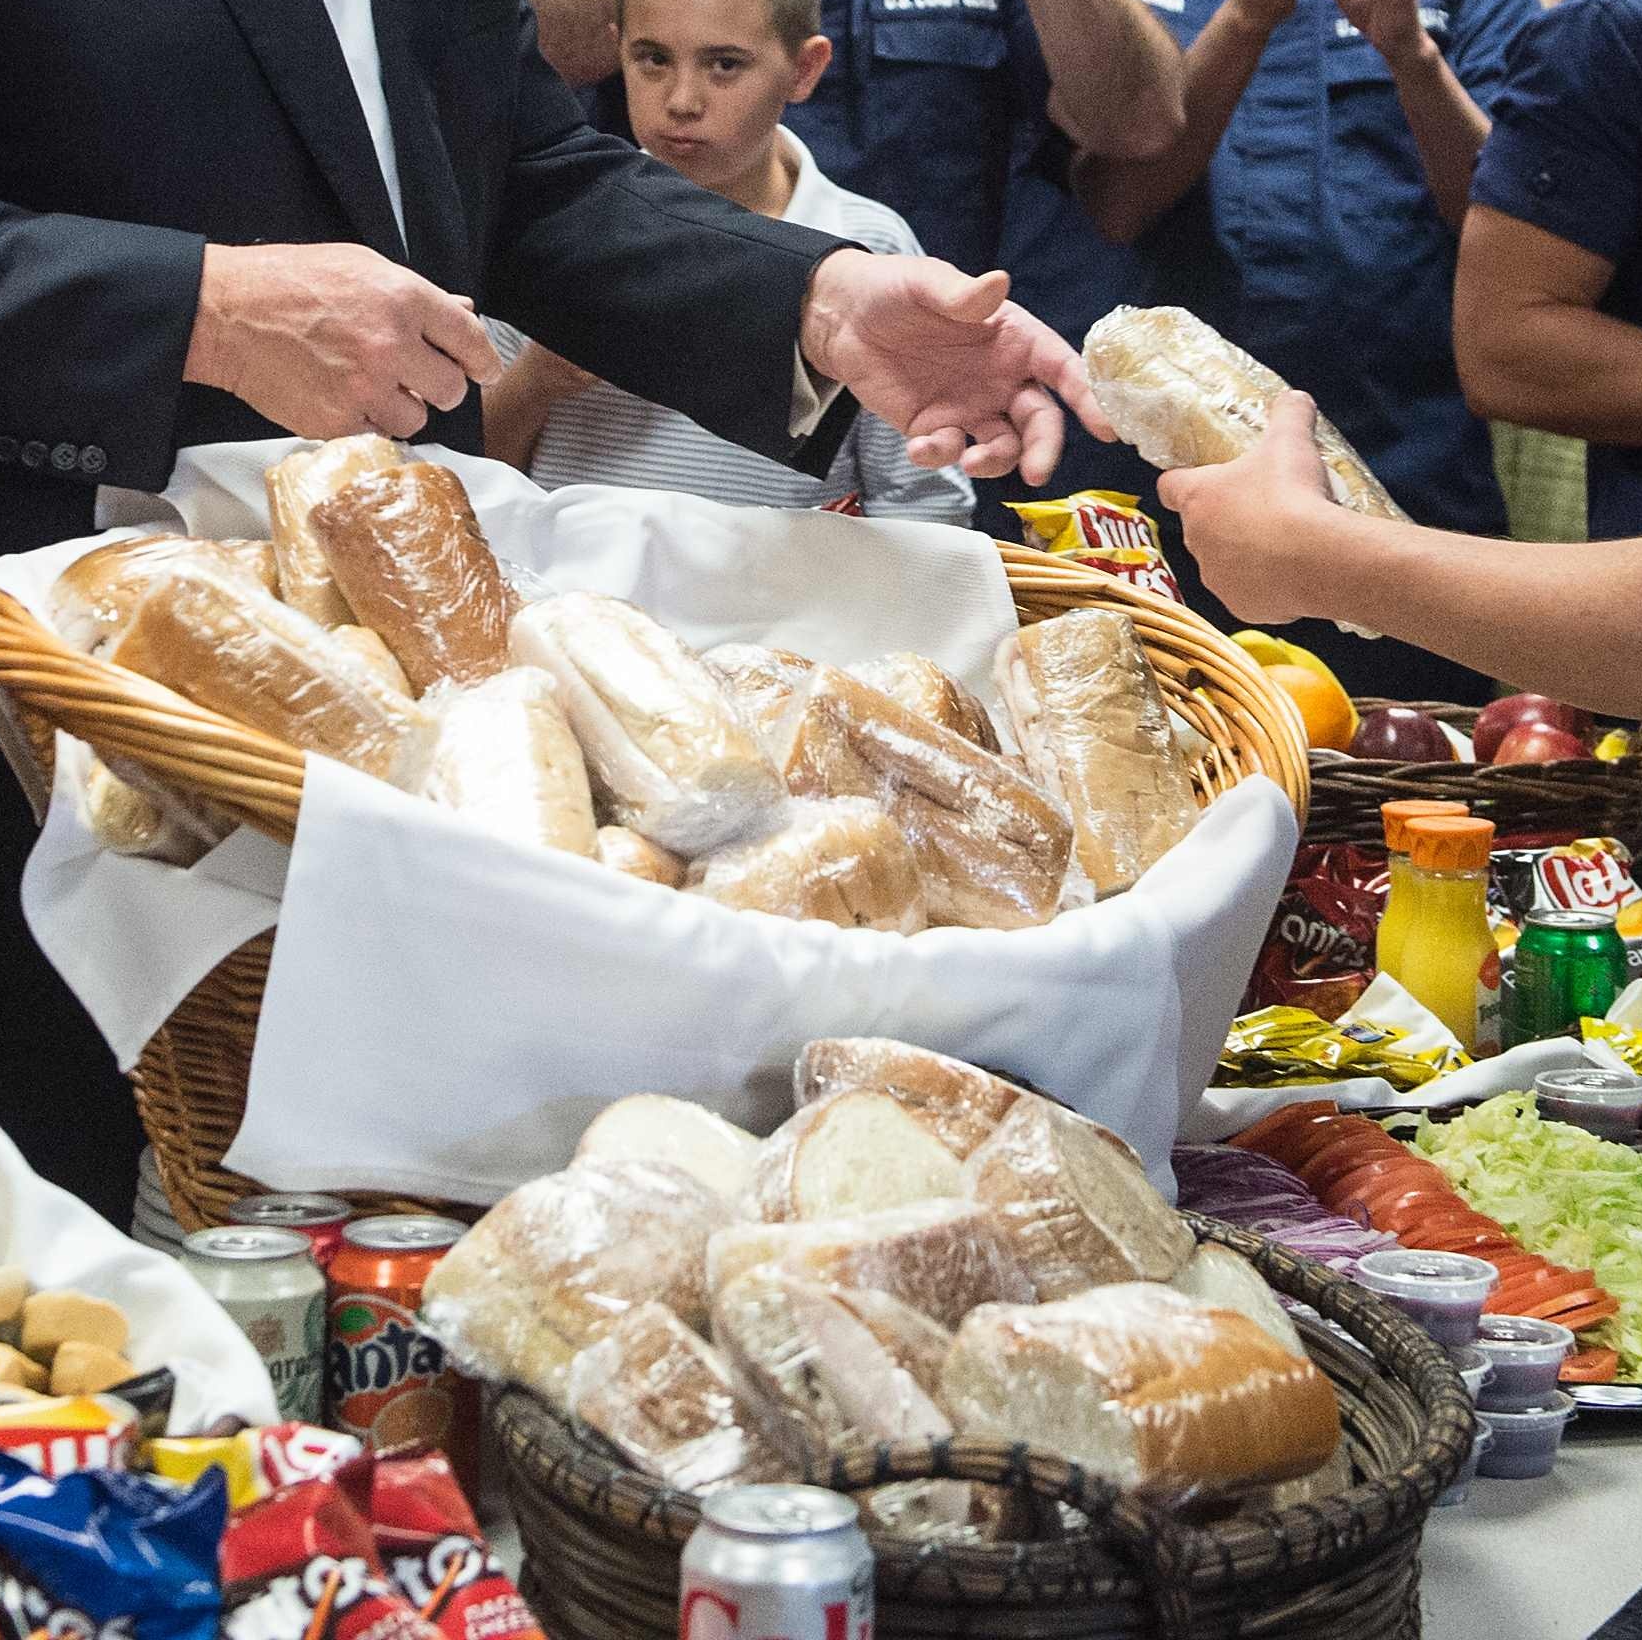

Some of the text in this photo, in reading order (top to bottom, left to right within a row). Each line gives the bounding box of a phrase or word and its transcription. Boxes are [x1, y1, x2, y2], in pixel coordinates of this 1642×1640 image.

[1551, 854, 1635, 909] Lay
[1280, 914, 1367, 968] oritos
[327, 1321, 445, 1402] anta
